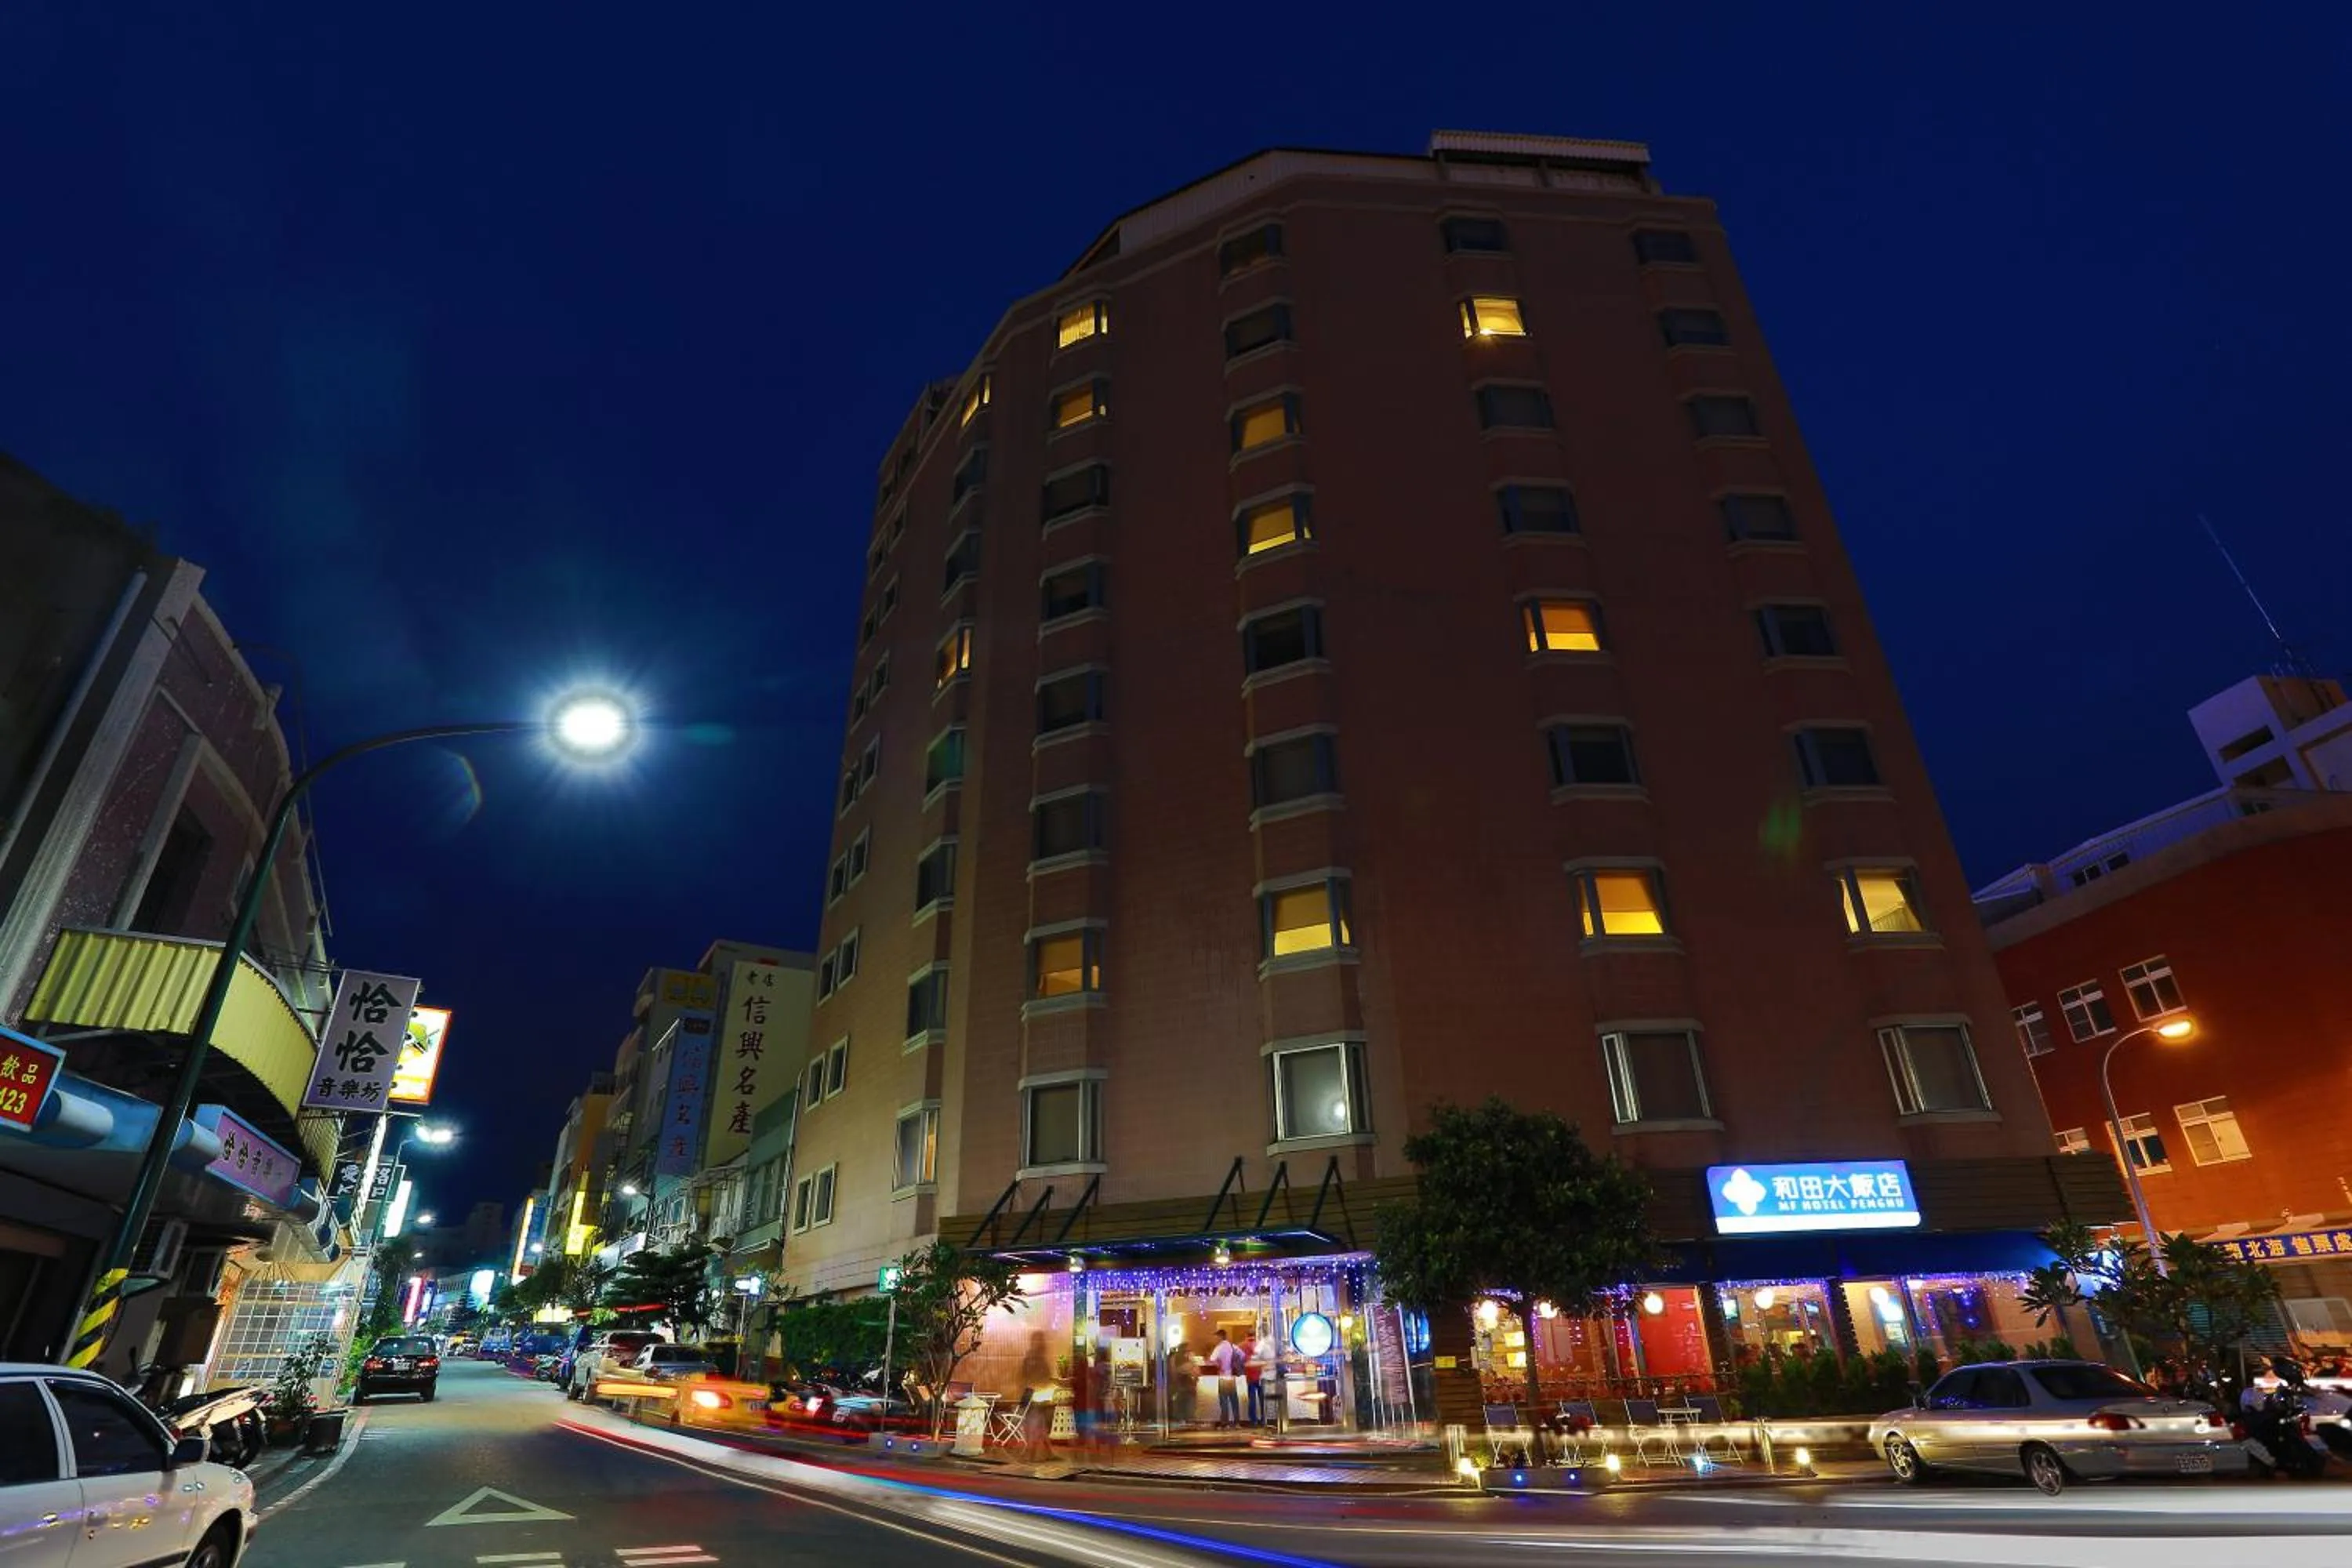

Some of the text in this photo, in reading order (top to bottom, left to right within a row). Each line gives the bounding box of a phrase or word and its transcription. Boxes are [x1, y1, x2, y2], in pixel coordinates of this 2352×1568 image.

[335, 981, 402, 1073] 恰恰
[728, 995, 771, 1134] 信興名產
[317, 1076, 383, 1102] 音樂坊
[1772, 1172, 1903, 1200] 和田大飯店
[1802, 1199, 1846, 1210] HOTEL
